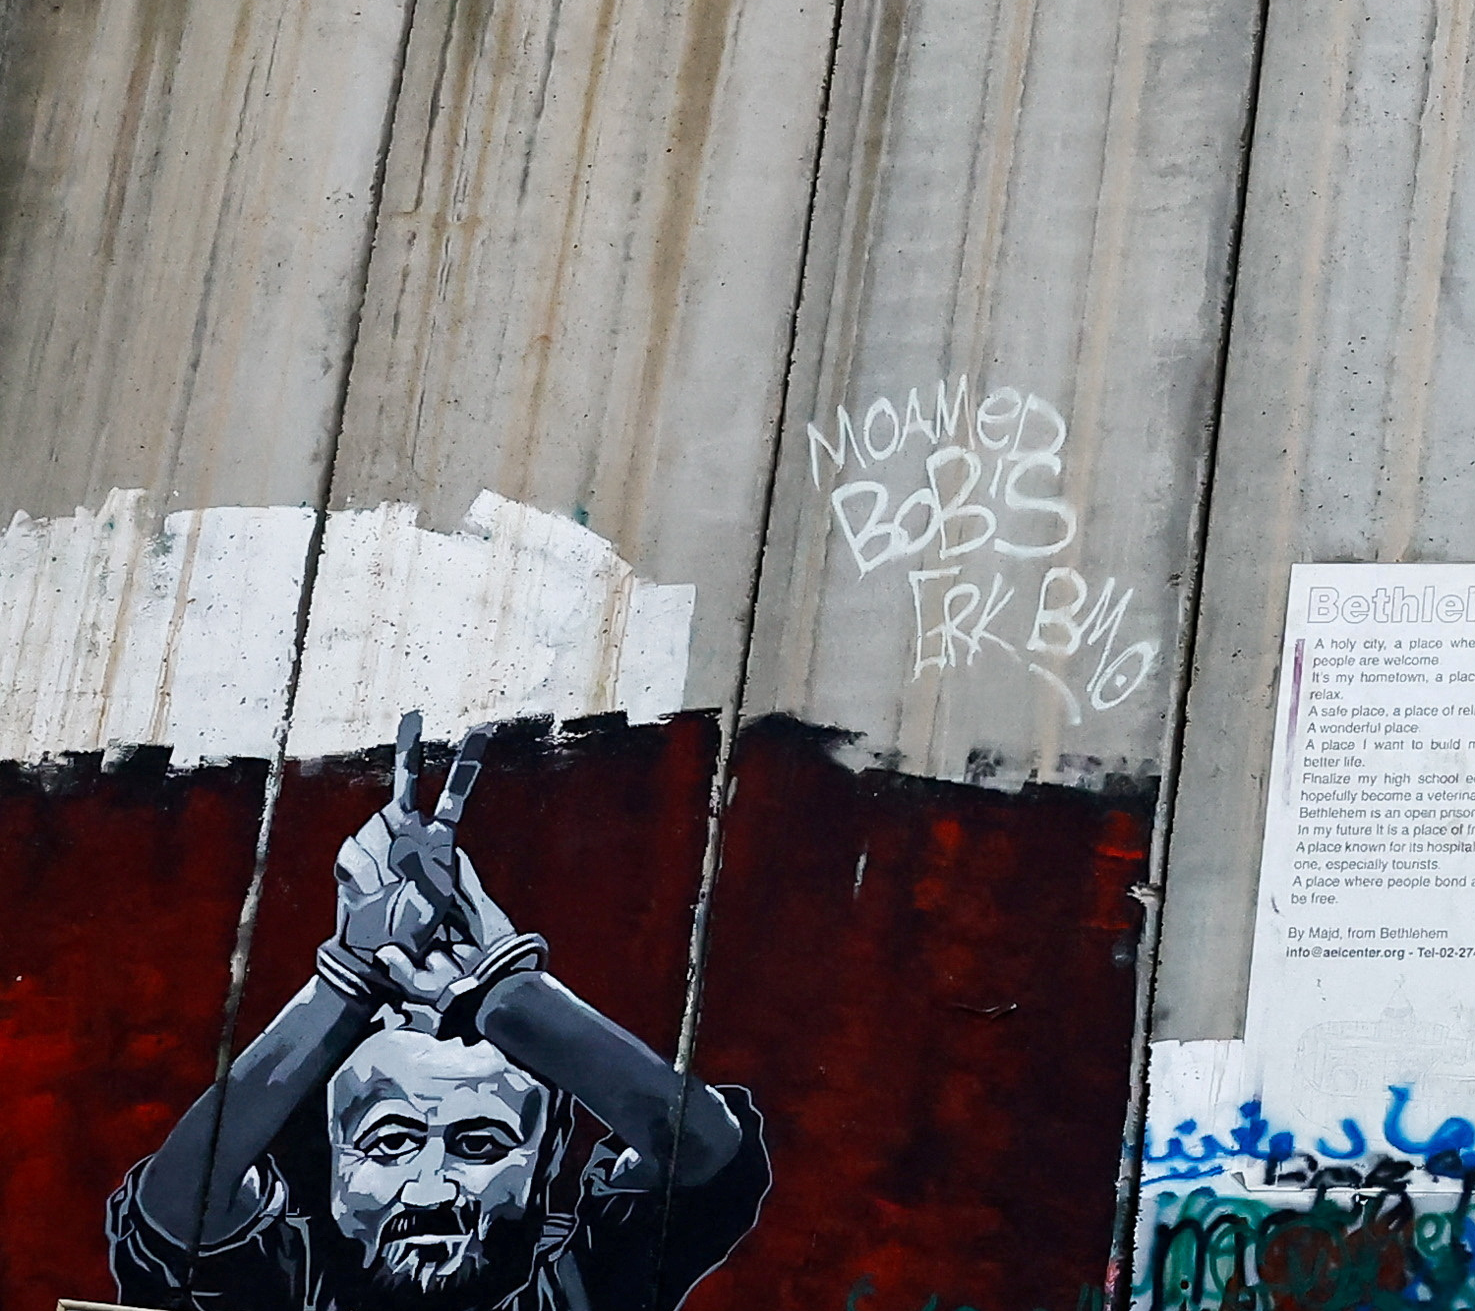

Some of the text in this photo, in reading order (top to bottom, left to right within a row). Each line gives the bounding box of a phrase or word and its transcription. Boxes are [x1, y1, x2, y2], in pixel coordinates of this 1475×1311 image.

[1313, 637, 1325, 650] A
[1330, 637, 1358, 653] holy
[1362, 638, 1387, 653] city,
[1393, 639, 1403, 650] a
[1408, 637, 1444, 652] place
[1307, 704, 1319, 718] A
[1320, 704, 1349, 718] safe
[1392, 706, 1401, 717] a
[1403, 704, 1439, 719] place
[1441, 704, 1455, 717] of
[1297, 824, 1310, 836] In
[1312, 825, 1333, 839] my
[1335, 823, 1373, 837] future
[1386, 823, 1398, 836] is
[1400, 825, 1410, 836] a
[1412, 822, 1449, 840] place
[1450, 822, 1465, 837] of
[1290, 892, 1308, 905] be
[1287, 926, 1306, 943] By
[1347, 926, 1376, 940] from
[1379, 926, 1449, 940] Bethlehem
